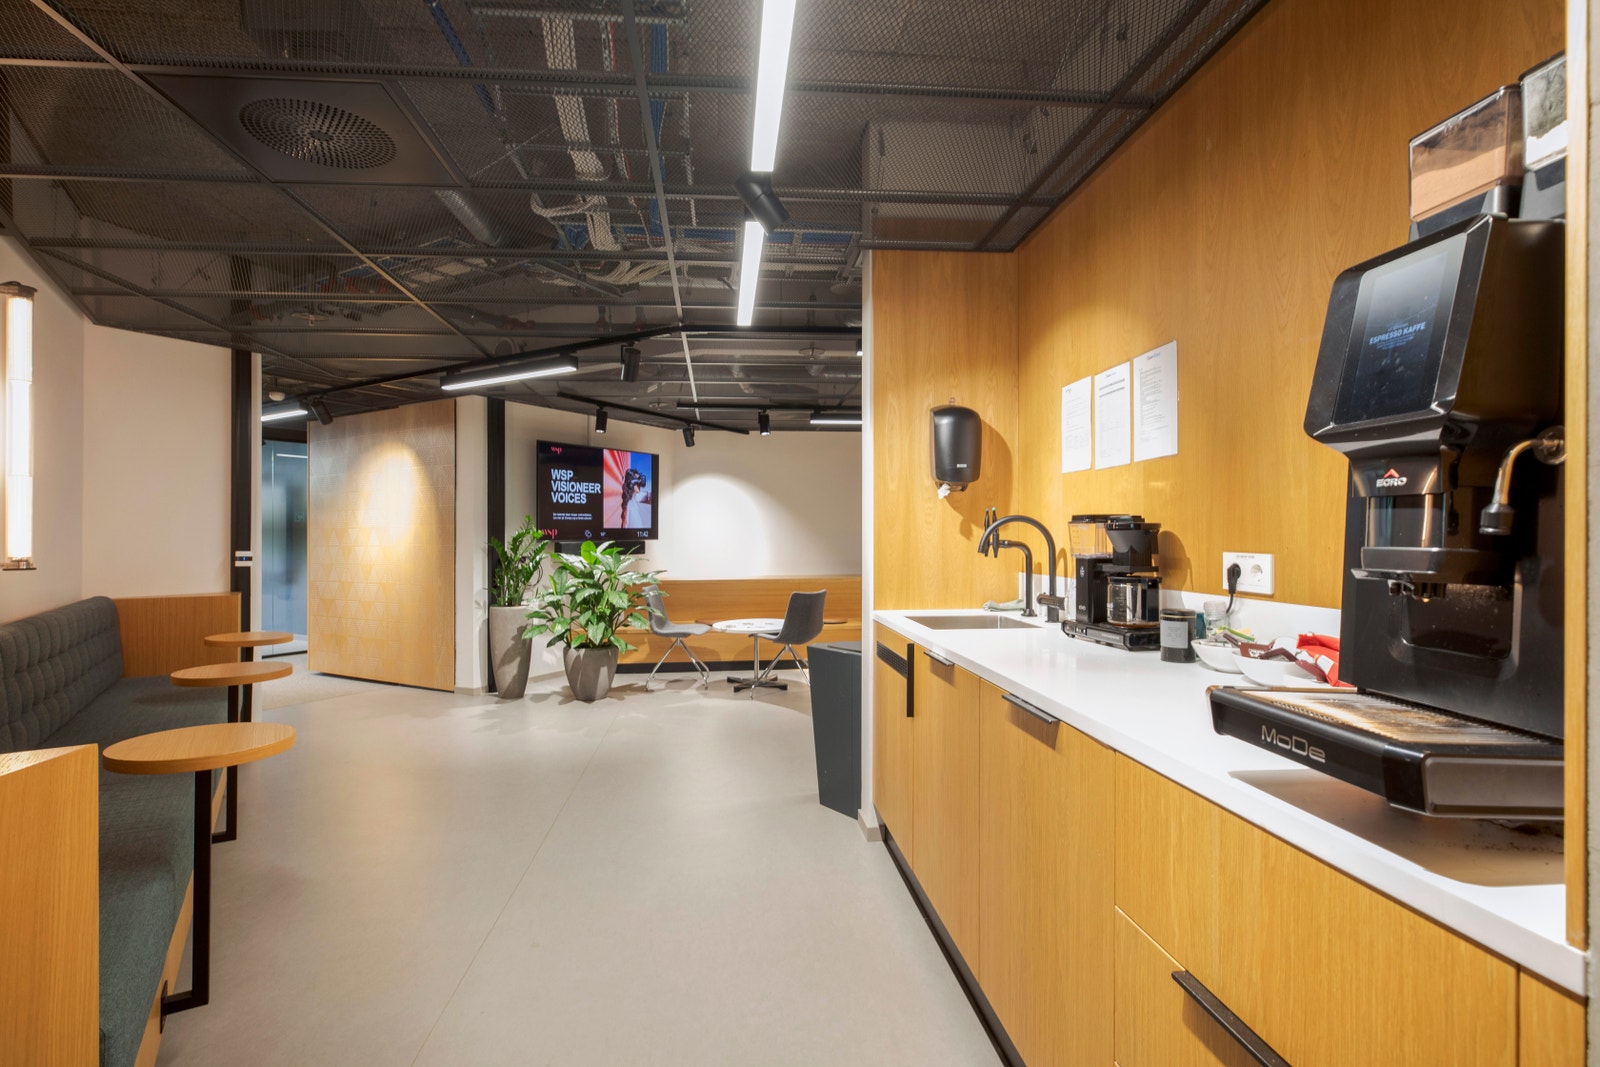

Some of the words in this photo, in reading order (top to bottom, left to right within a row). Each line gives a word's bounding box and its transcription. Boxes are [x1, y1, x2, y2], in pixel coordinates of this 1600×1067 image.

[1369, 329, 1403, 345] ESPRESSO
[551, 468, 574, 480] WSP
[551, 480, 601, 494] VISIONEER
[551, 491, 587, 504] VOICES
[1261, 724, 1326, 764] MoDe
